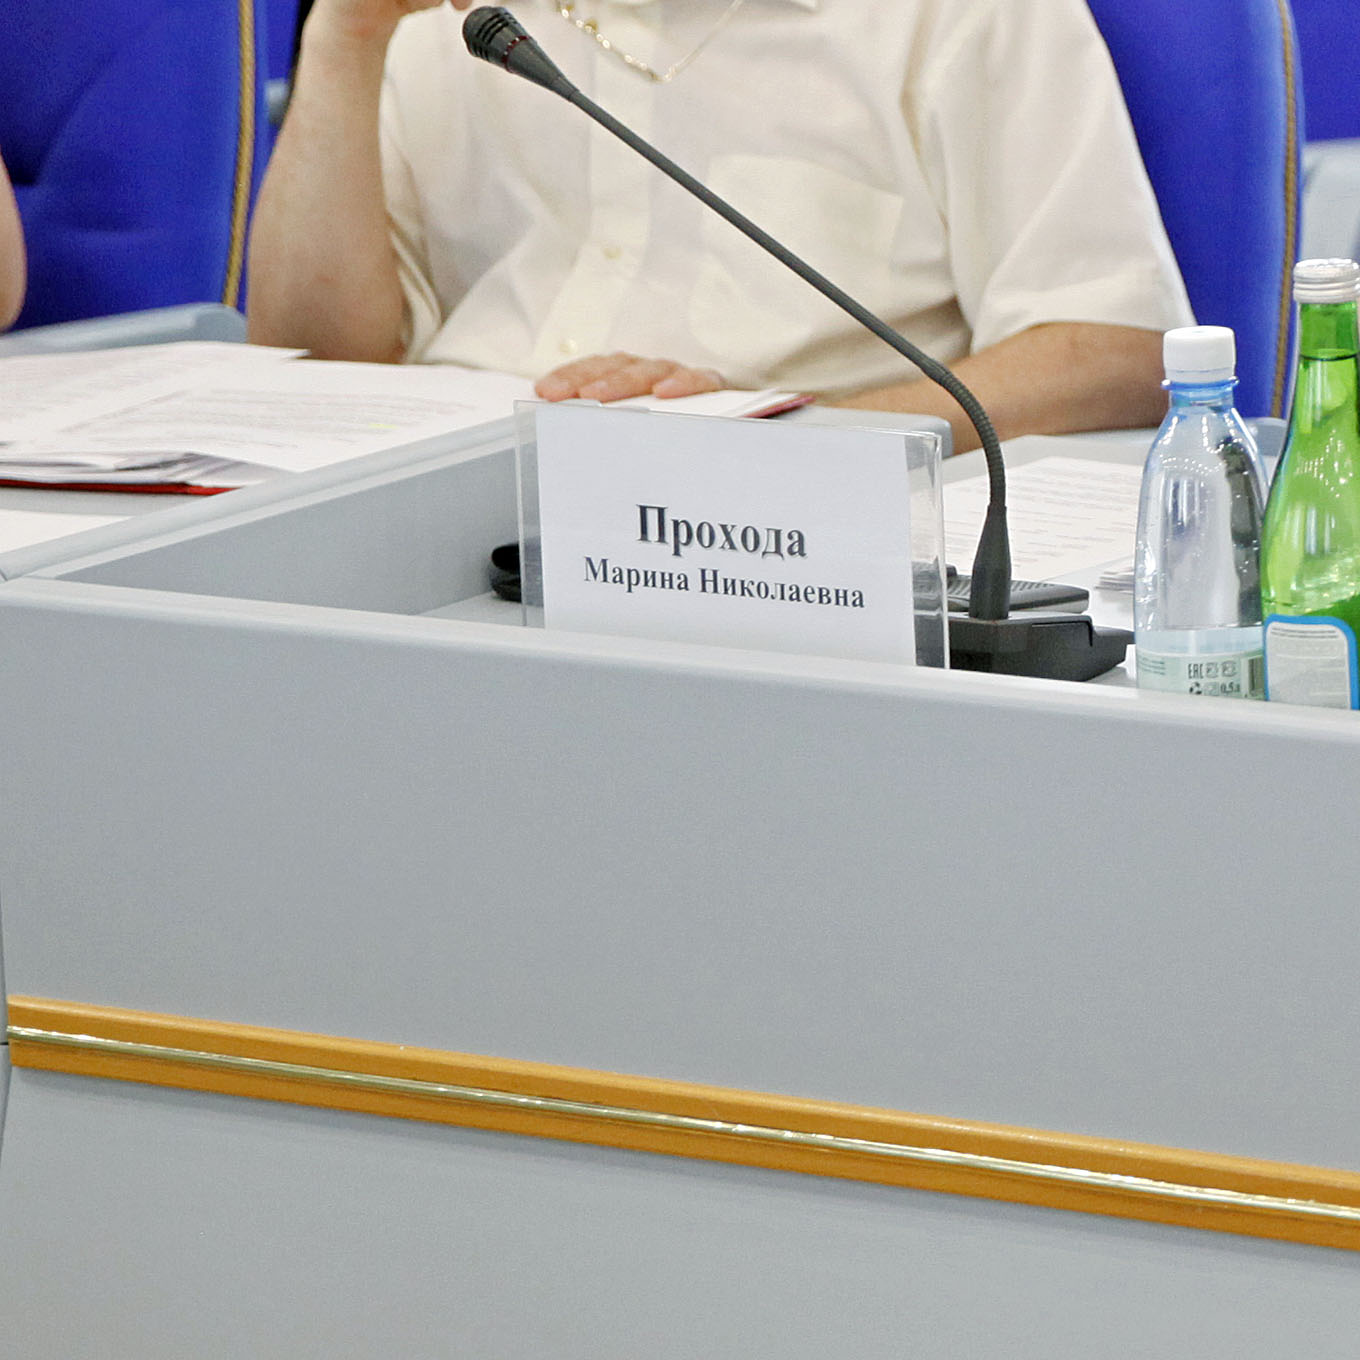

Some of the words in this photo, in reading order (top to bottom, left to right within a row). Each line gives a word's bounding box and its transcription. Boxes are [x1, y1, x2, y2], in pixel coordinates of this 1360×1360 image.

[635, 503, 808, 559] Прохода
[583, 556, 690, 593] Марина
[699, 567, 866, 609] Николаевна
